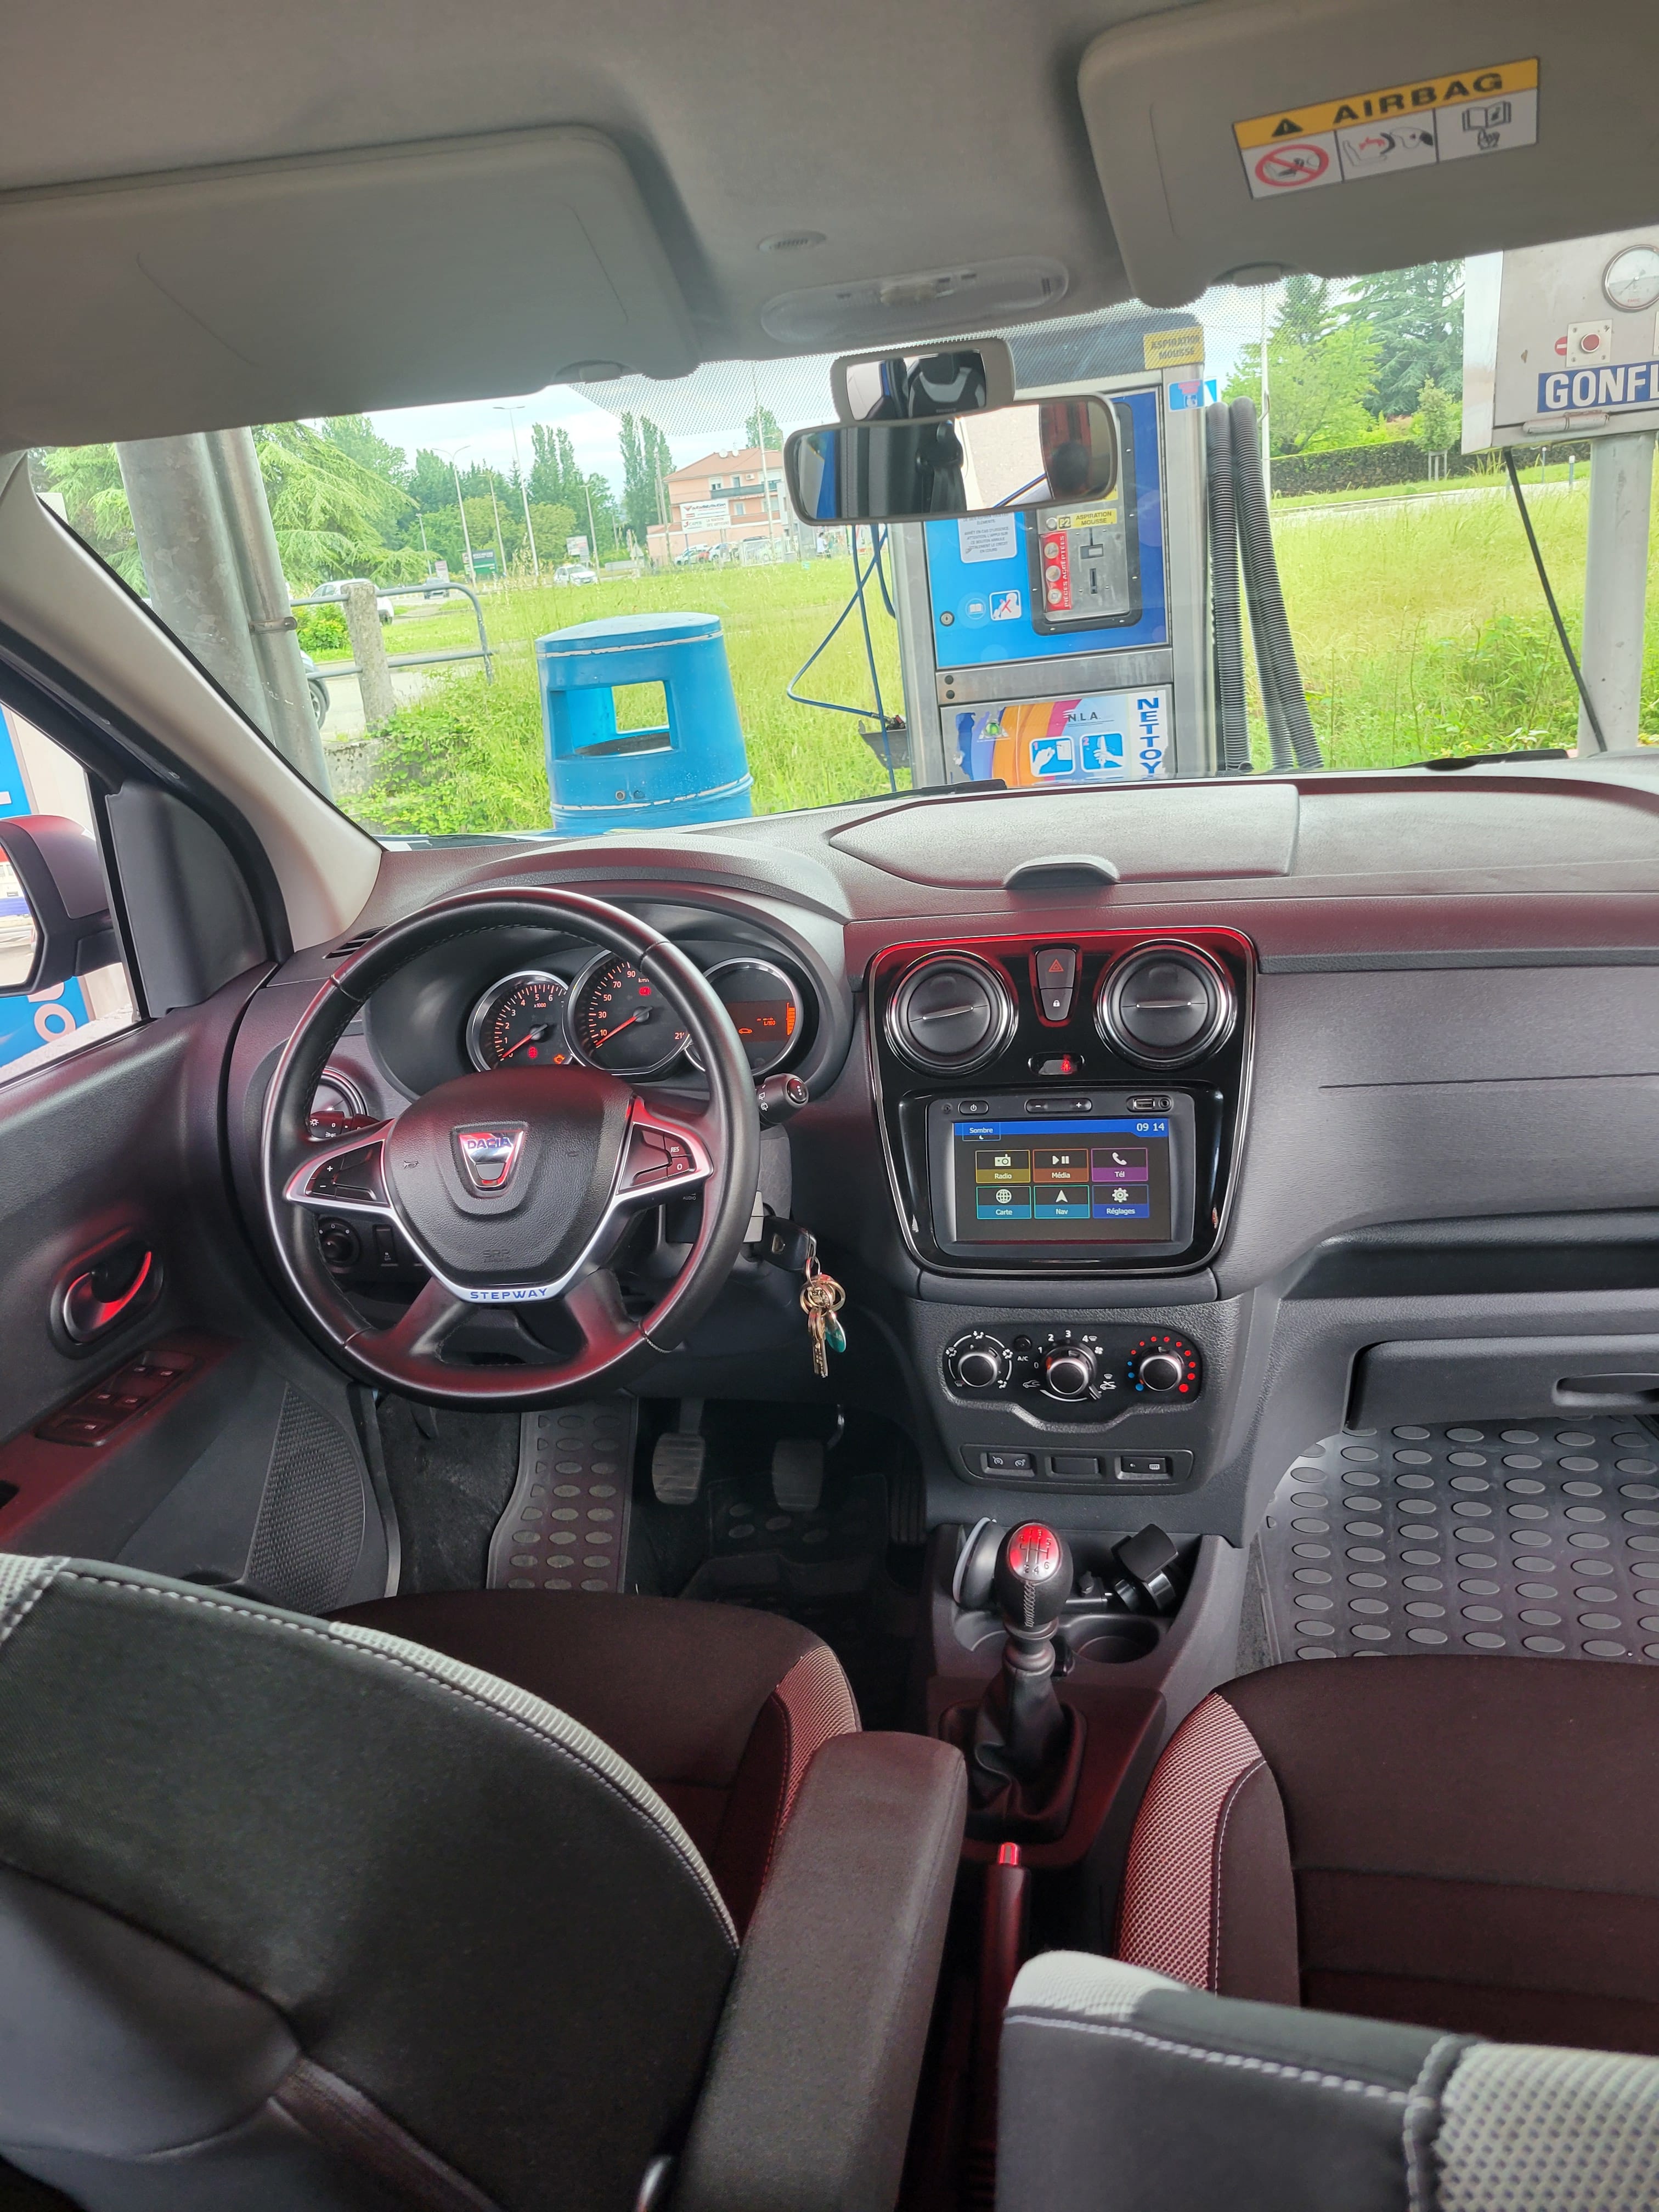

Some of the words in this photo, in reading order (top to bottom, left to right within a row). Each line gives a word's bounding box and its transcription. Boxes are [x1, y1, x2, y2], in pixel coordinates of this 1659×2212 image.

[1333, 73, 1503, 124] AIRBAG
[1076, 511, 1111, 520] ASPIRATION
[1137, 697, 1162, 774] NETTOY
[1083, 737, 1090, 746] 2
[1136, 1122, 1149, 1132] 09
[1153, 1122, 1165, 1131] 14
[467, 1137, 512, 1149] DACIA
[1106, 1207, 1136, 1215] Réglages
[470, 1288, 547, 1300] STEPWAY
[1048, 1334, 1054, 1342] 2
[1082, 1335, 1088, 1343] 4
[1044, 1561, 1050, 1570] 6
[1032, 1566, 1039, 1575] 4
